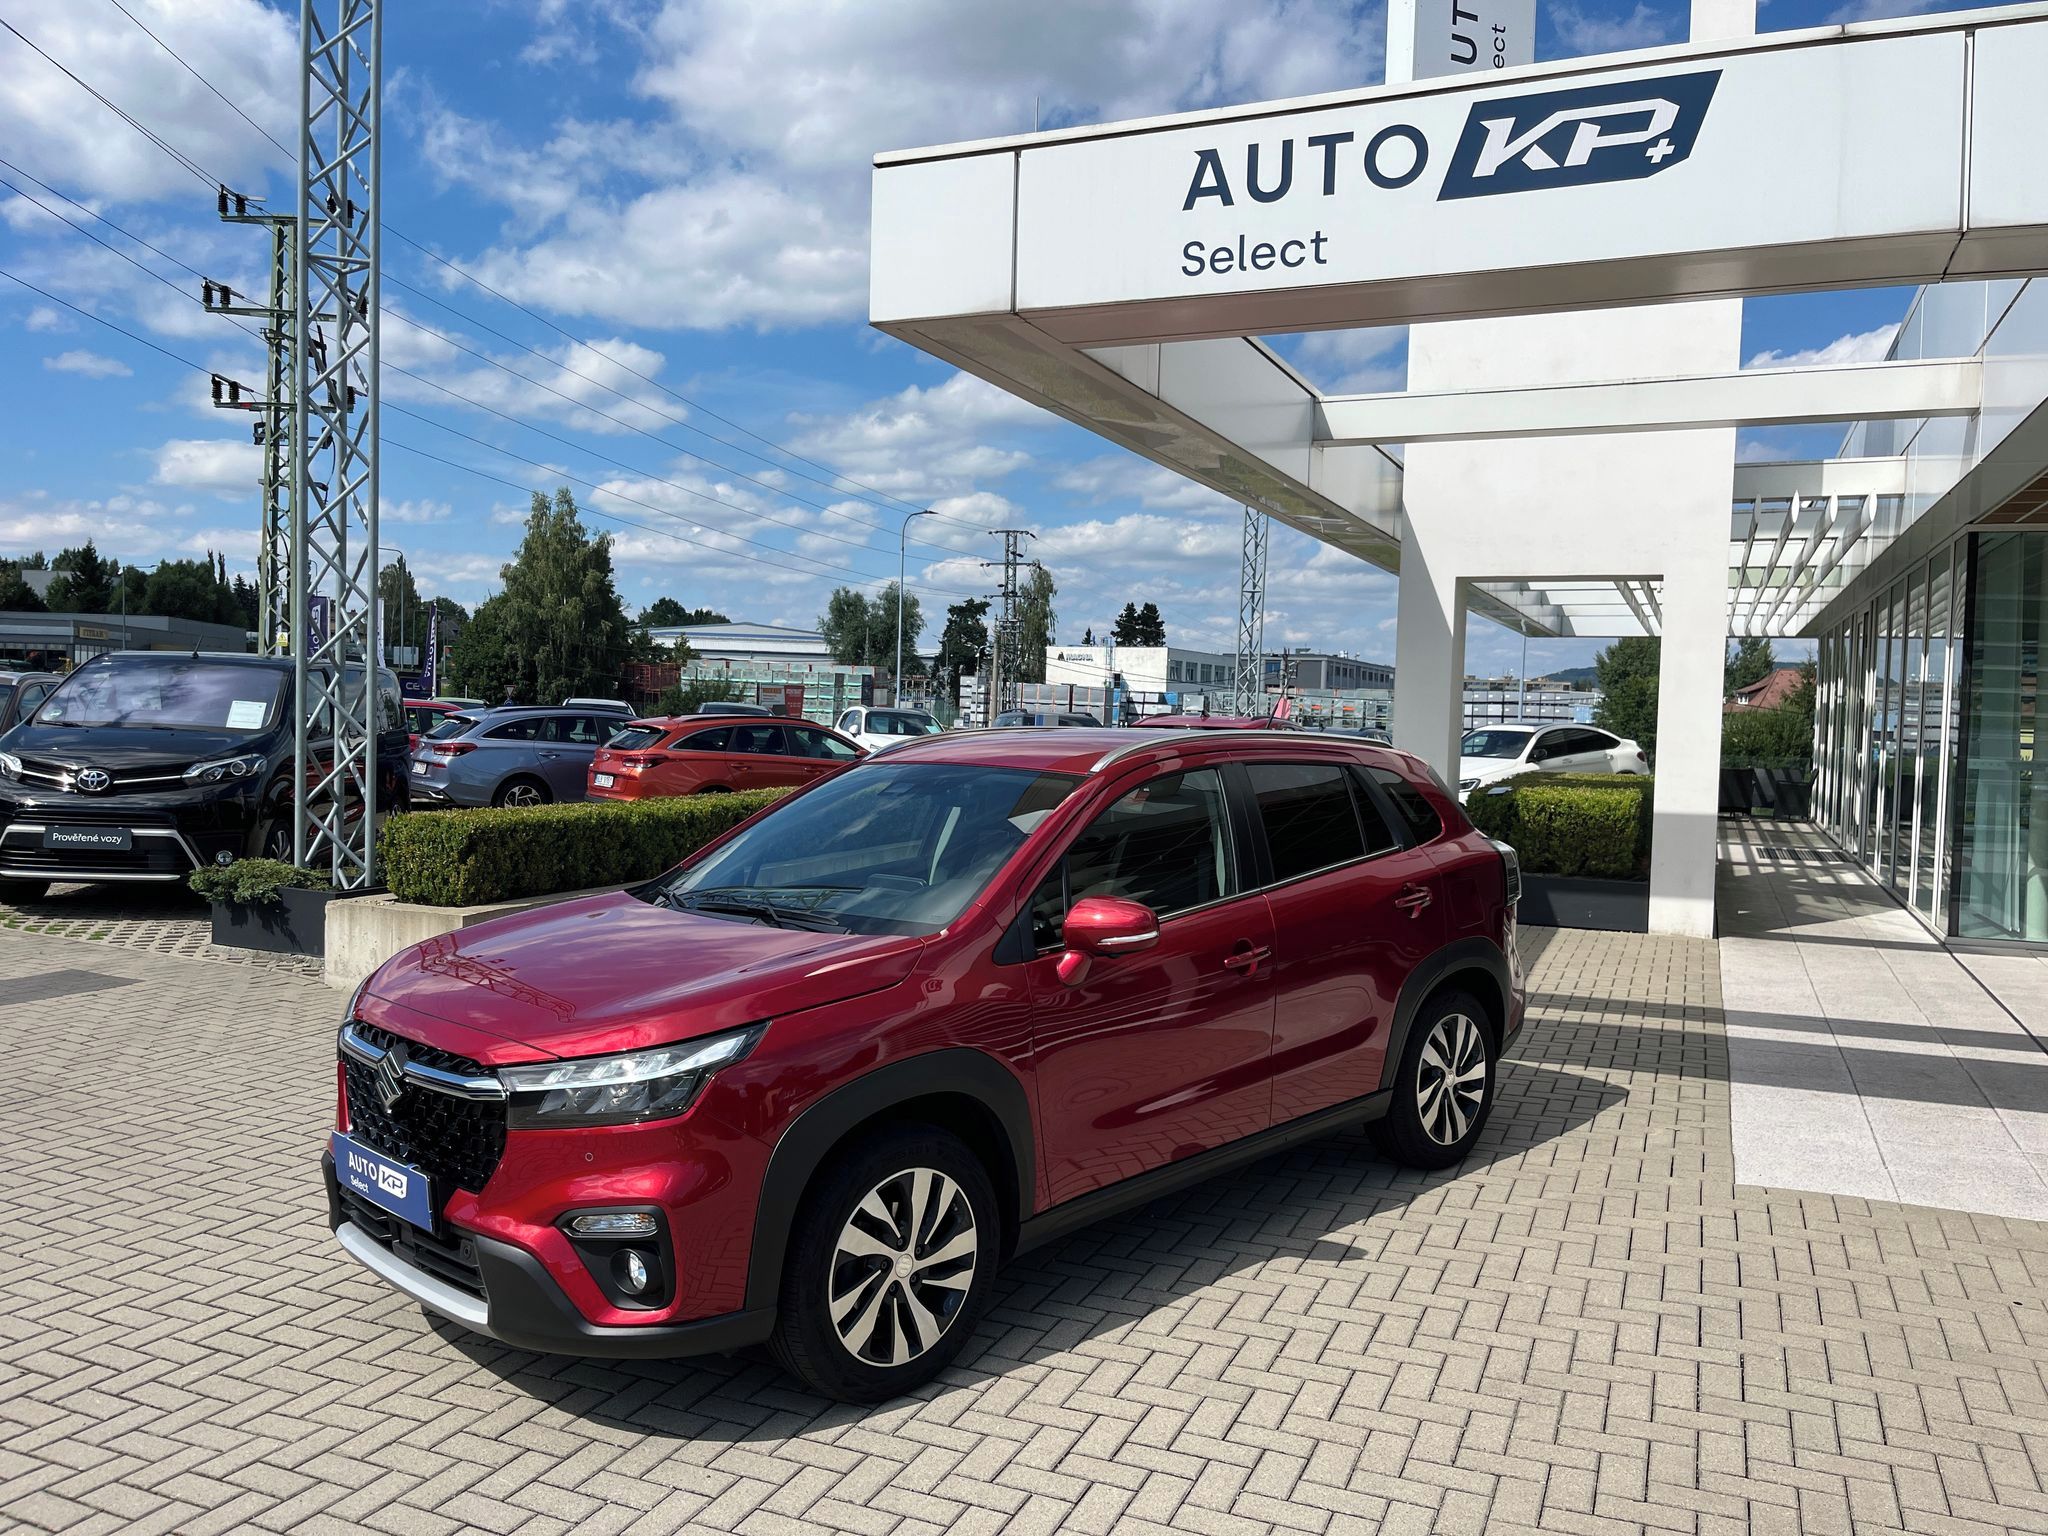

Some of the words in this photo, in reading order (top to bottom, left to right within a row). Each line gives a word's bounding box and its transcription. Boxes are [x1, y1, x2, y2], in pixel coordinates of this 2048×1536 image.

[1450, 0, 1479, 65] UT
[1491, 23, 1506, 69] ect
[1181, 123, 1430, 211] AUTO
[1181, 230, 1329, 277] Select
[52, 832, 99, 842] Prověřené
[100, 835, 122, 845] vozy
[348, 1151, 378, 1181] AUTO
[350, 1174, 370, 1194] Select
